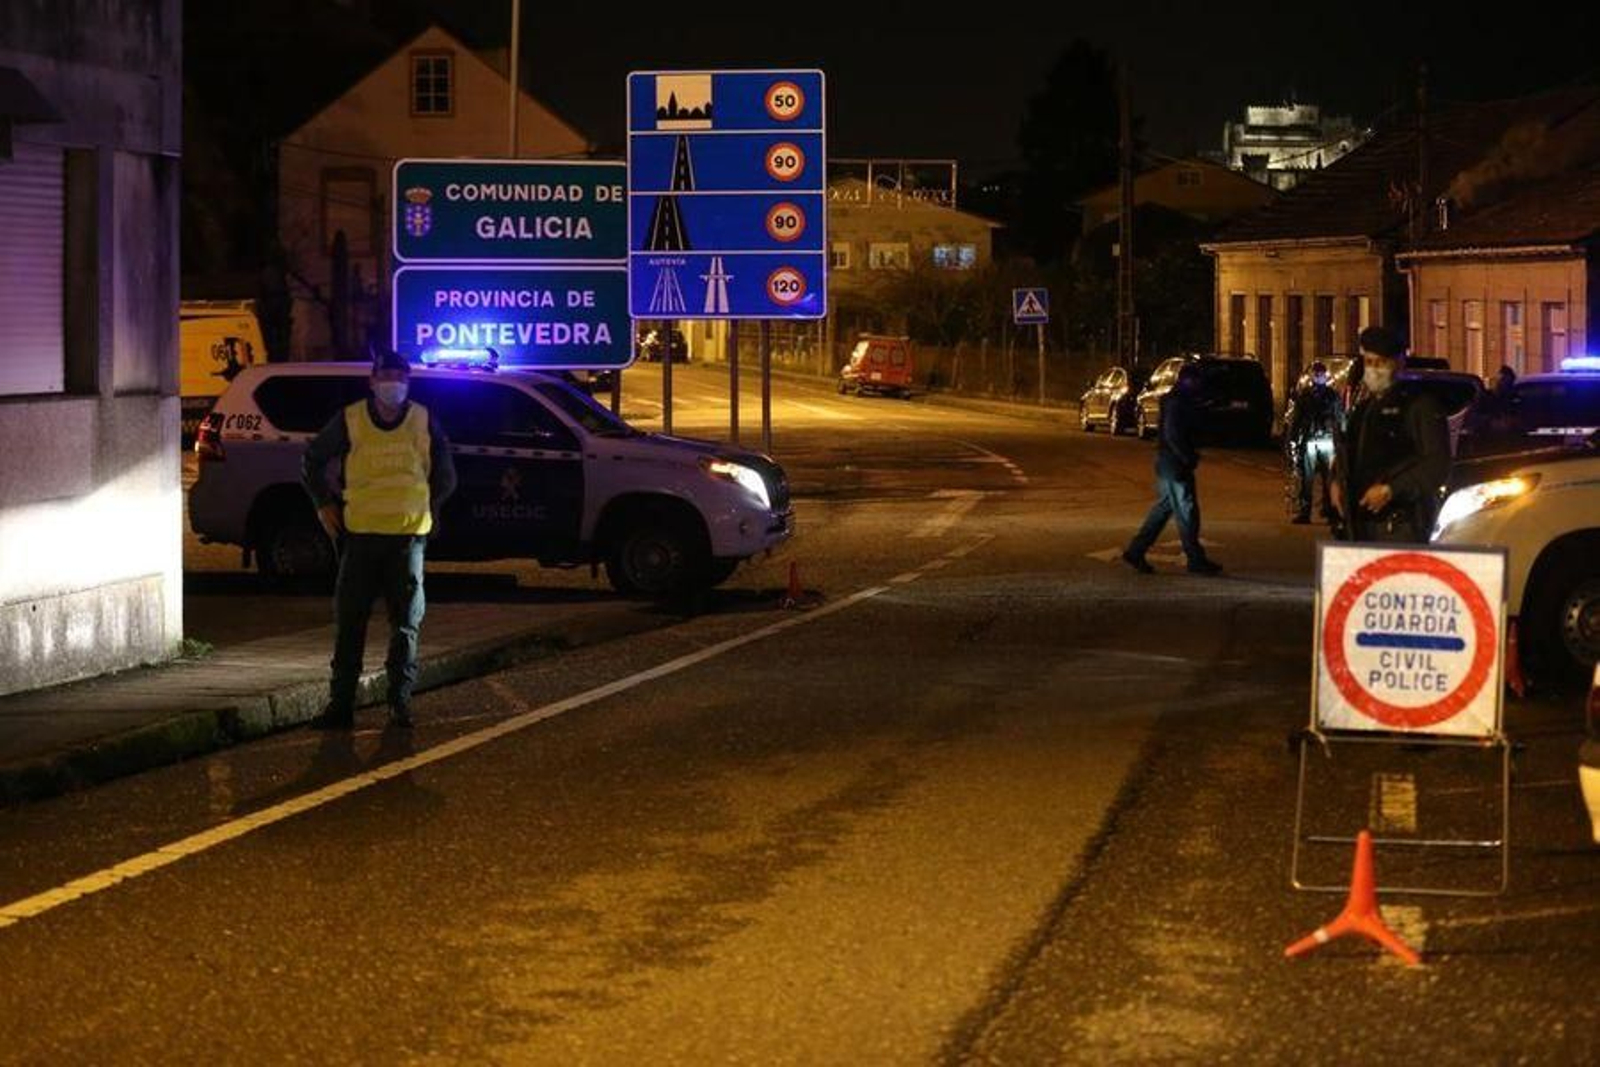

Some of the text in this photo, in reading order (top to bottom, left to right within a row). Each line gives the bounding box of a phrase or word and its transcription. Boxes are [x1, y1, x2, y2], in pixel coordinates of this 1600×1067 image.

[775, 95, 795, 108] 50
[774, 155, 796, 169] 90
[445, 184, 624, 202] COMUNIDAD DE
[476, 215, 593, 240] GALICIA
[774, 215, 797, 229] 90
[773, 279, 800, 293] 120
[434, 290, 596, 308] PROVINCIA DE
[416, 322, 612, 346] PONTEVEDRA
[1364, 592, 1461, 614] CONTROL
[1364, 613, 1457, 633] GUARDIA
[1380, 651, 1437, 671] CIVIL
[1369, 671, 1448, 692] POLICE
